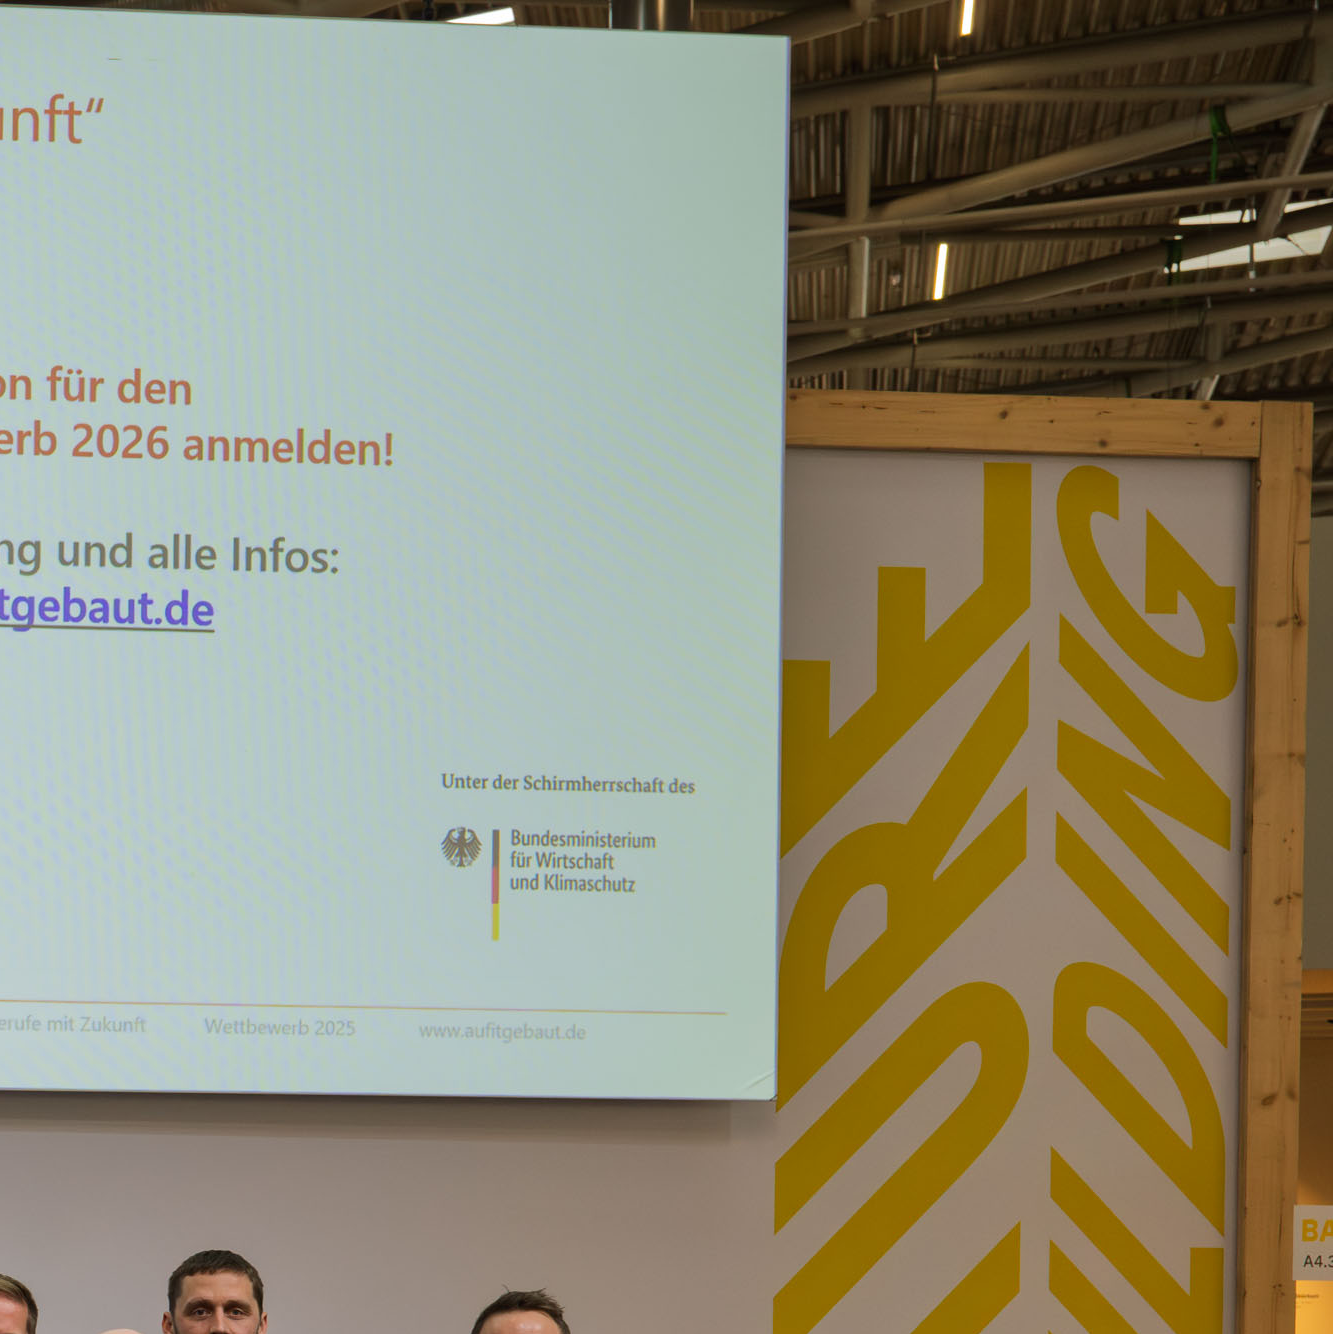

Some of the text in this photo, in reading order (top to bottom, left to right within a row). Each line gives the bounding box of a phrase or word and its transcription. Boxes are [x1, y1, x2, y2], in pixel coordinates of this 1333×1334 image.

[46, 364, 105, 403] für
[117, 367, 192, 406] den
[72, 423, 170, 460] 2026
[183, 427, 393, 467] anmelden!
[58, 531, 133, 569] und
[147, 533, 217, 571] alle
[232, 536, 339, 575] Infos:
[441, 772, 696, 795] Unter der Schirmherrschaft des
[510, 829, 657, 850] Bundesministerium
[511, 850, 615, 870] für Wirtschaft
[509, 873, 636, 893] und Klimaschutz
[46, 1015, 75, 1032] mit
[79, 1015, 147, 1033] Zukunft
[203, 1017, 357, 1037] Wettbewerb 2025
[418, 1022, 587, 1044] www.aufitgebaut.de
